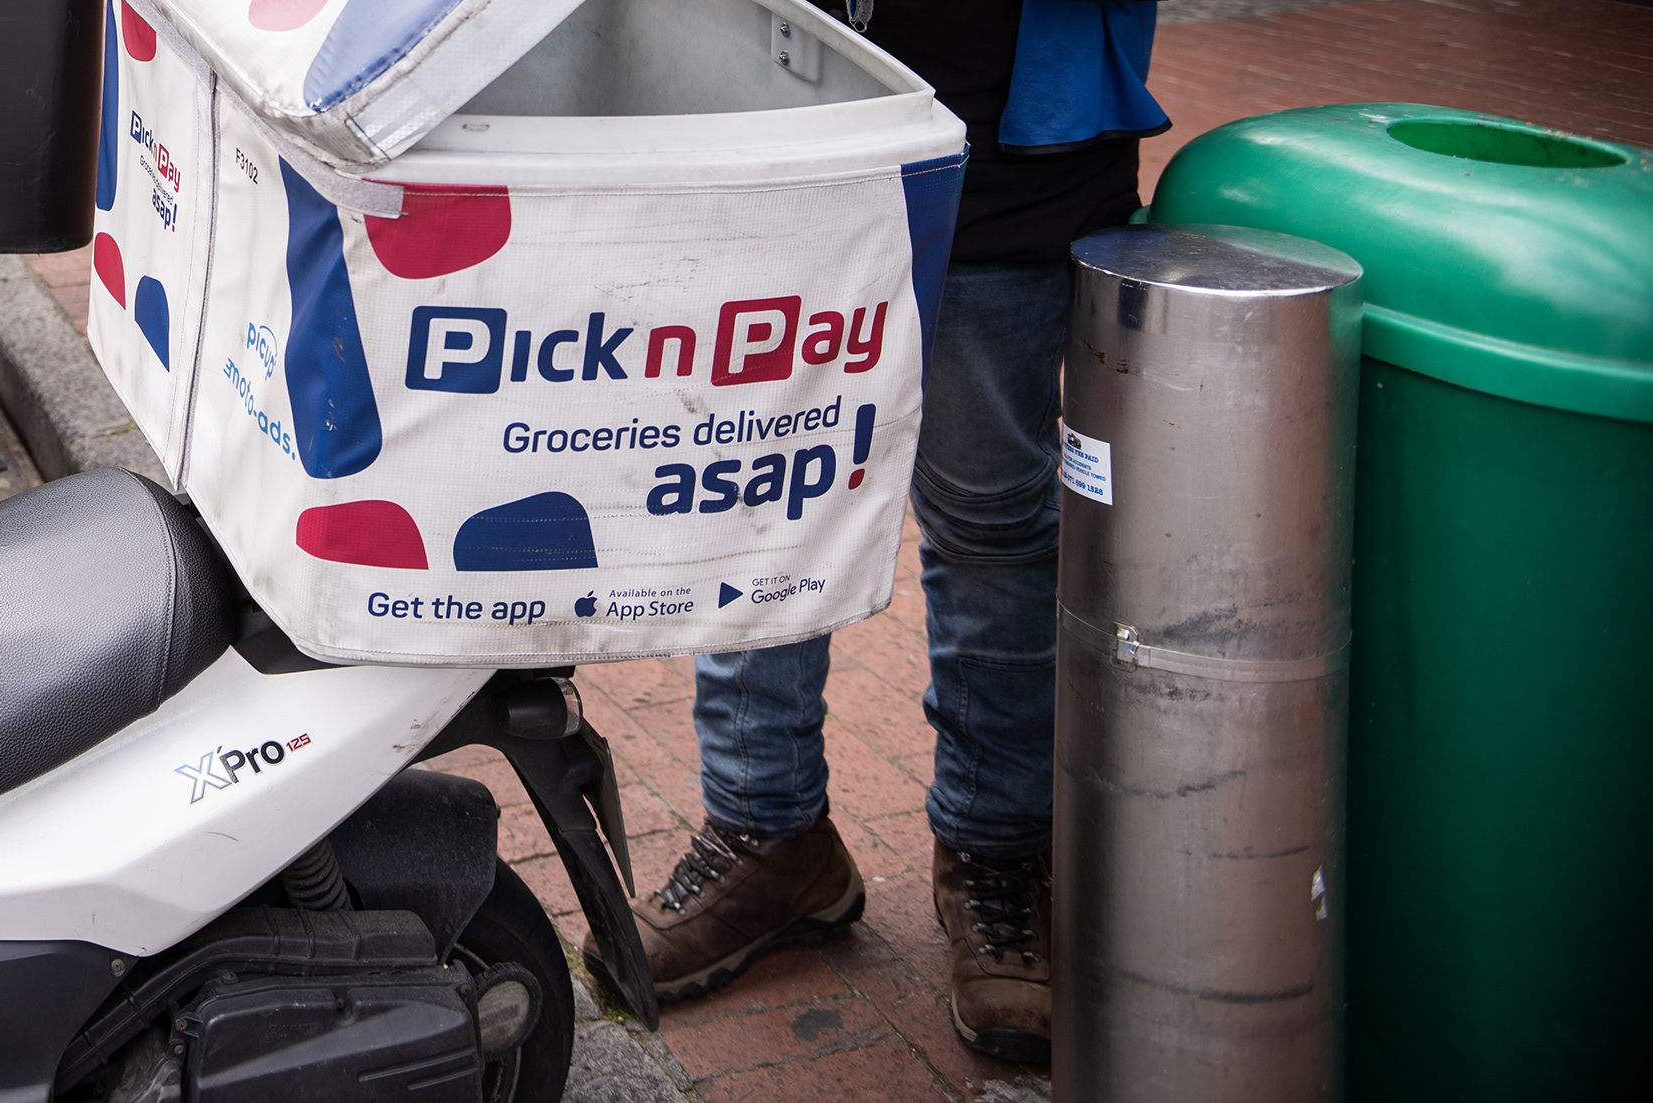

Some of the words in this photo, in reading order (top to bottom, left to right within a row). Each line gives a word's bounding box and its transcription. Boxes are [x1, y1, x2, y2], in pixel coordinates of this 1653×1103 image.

[130, 109, 155, 155] Pick
[158, 143, 181, 194] Pay
[235, 147, 259, 185] F3102
[152, 188, 178, 232] asap!
[247, 322, 277, 382] picup
[404, 305, 634, 394] Pick
[645, 325, 697, 379] n
[710, 295, 889, 387] Pay
[502, 417, 681, 454] Groceries
[692, 395, 843, 447] delivered
[646, 403, 877, 521] asap!
[1087, 484, 1103, 496] 1528
[609, 589, 657, 598] Available
[659, 589, 673, 597] on
[675, 587, 692, 596] the
[751, 586, 797, 605] Google
[799, 577, 826, 595] Play
[752, 577, 770, 587] GET
[771, 576, 779, 585] IT
[779, 574, 791, 583] ON
[367, 592, 424, 620] Get
[430, 594, 487, 620] the
[491, 598, 547, 626] app
[606, 601, 646, 621] App
[648, 599, 694, 618] Store
[286, 733, 313, 753] 125
